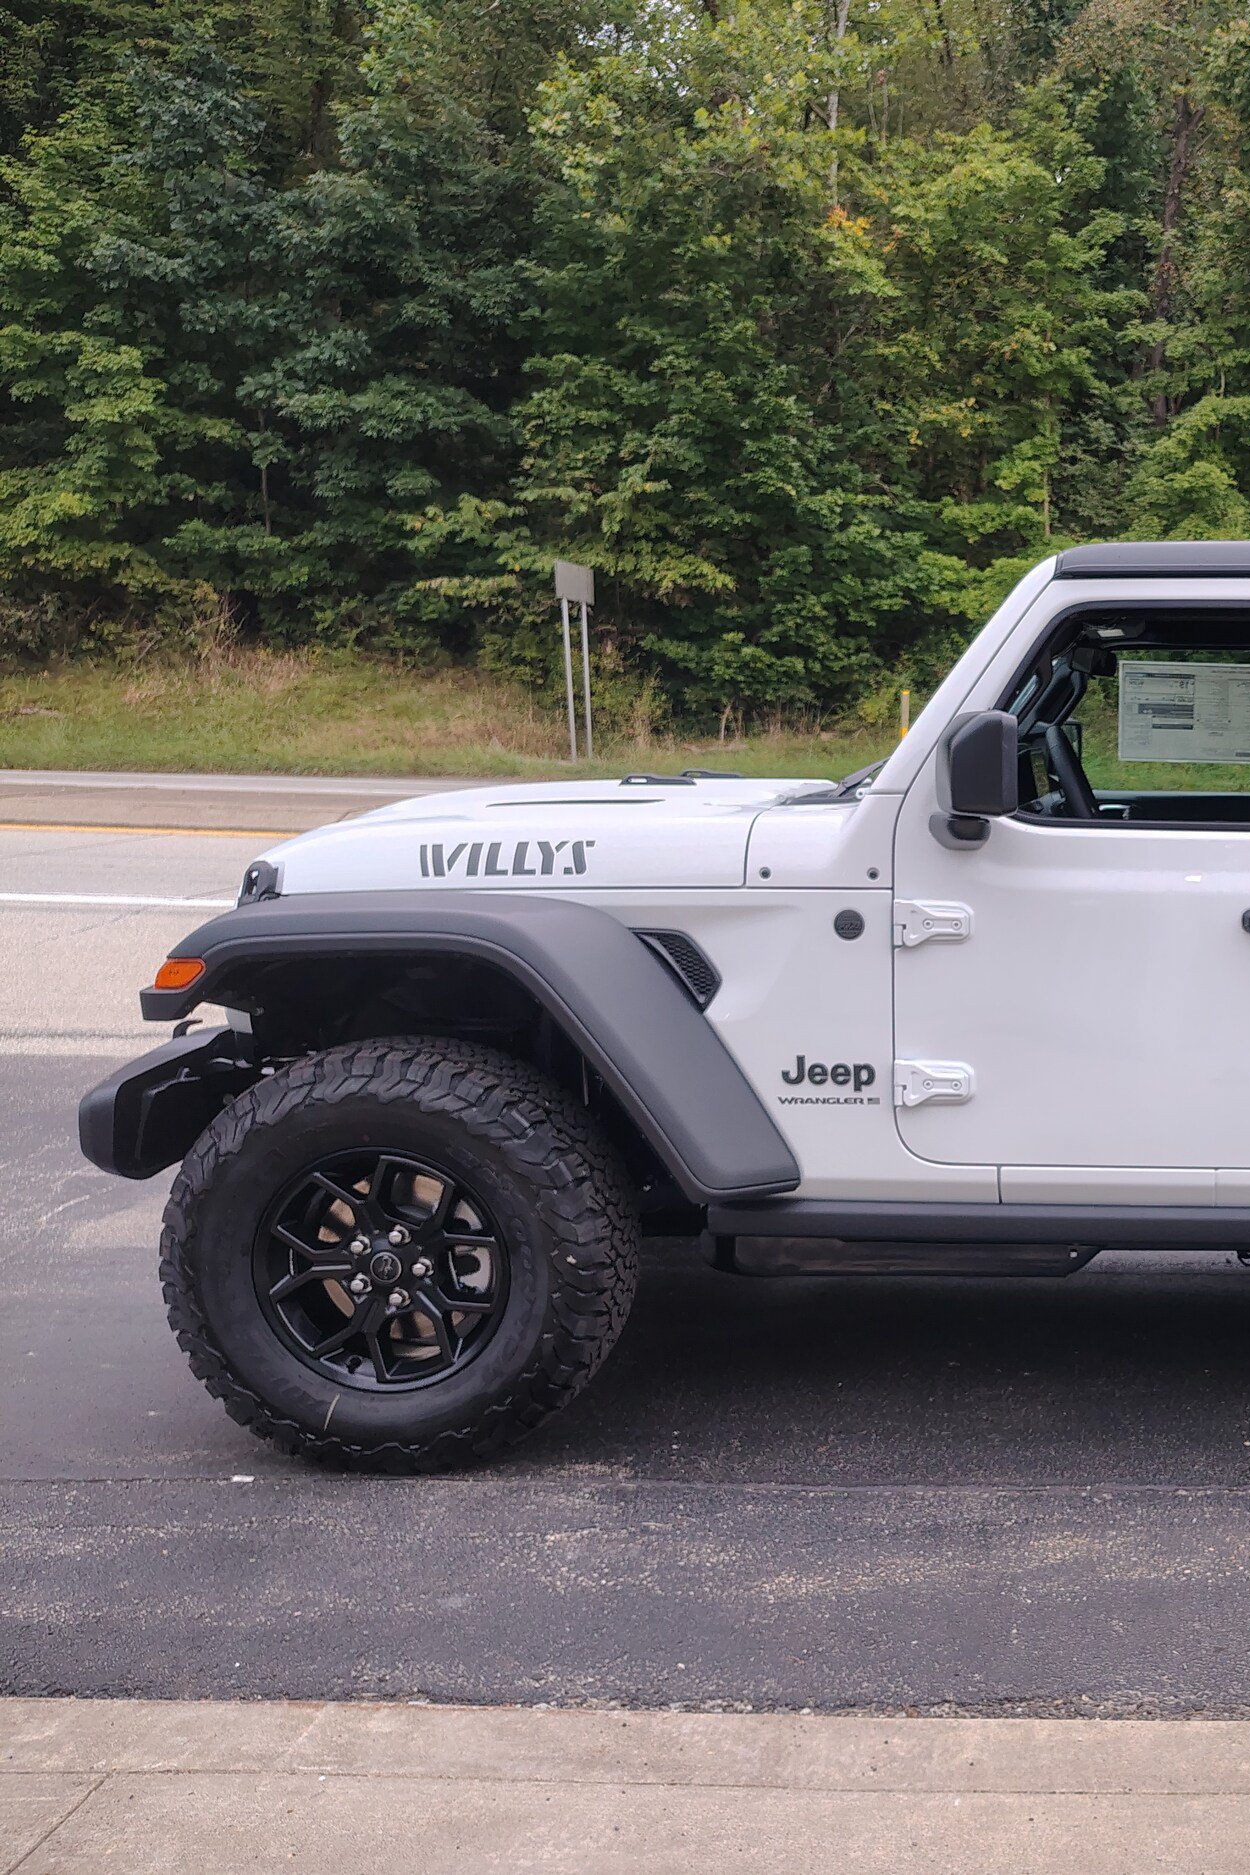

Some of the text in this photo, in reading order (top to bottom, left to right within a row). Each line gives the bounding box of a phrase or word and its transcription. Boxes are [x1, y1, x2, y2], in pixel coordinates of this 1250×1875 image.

[419, 841, 596, 877] WILLYS
[781, 1054, 876, 1092] Jeep
[778, 1096, 865, 1105] WRANGLER
